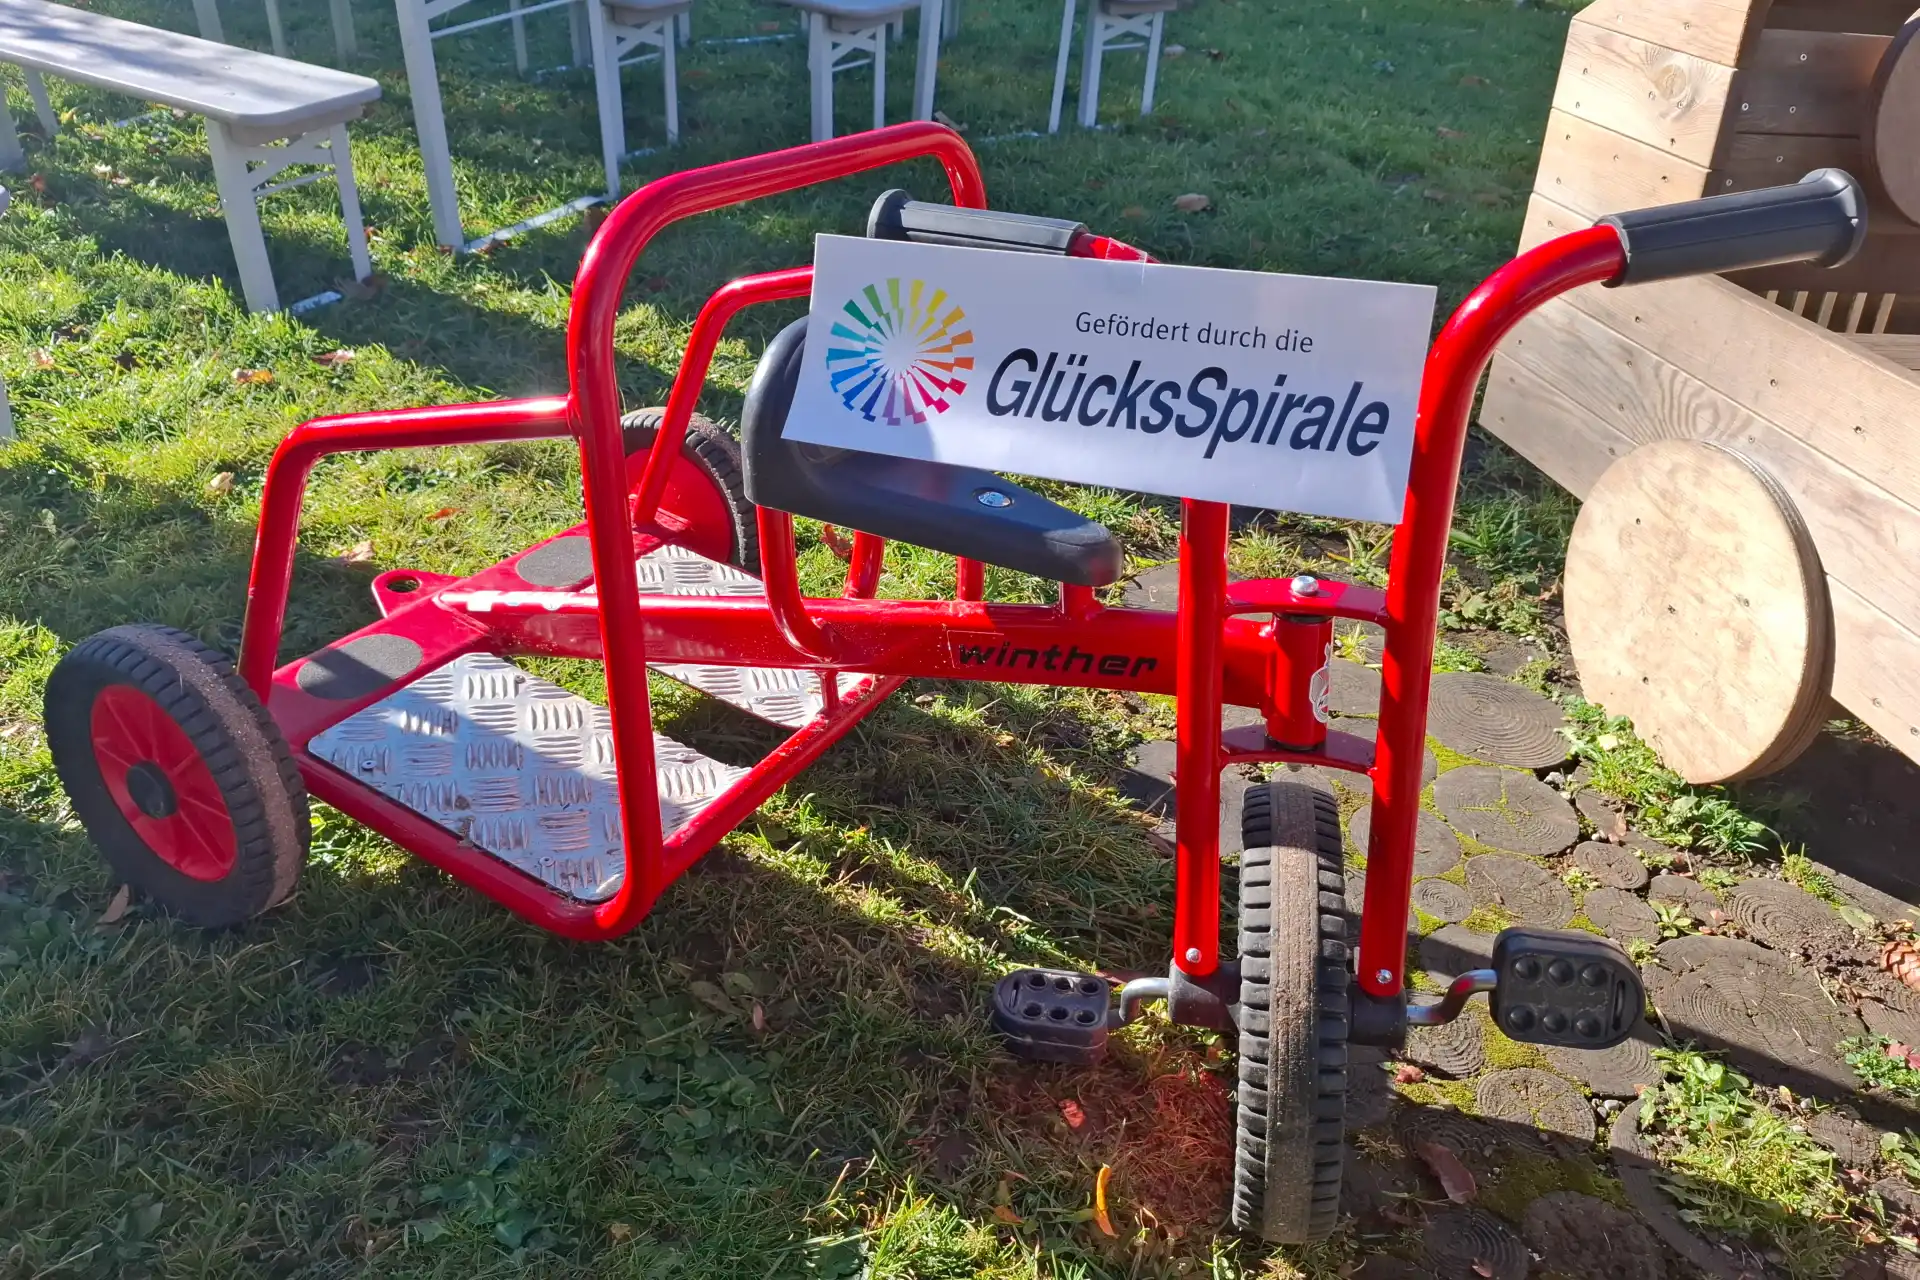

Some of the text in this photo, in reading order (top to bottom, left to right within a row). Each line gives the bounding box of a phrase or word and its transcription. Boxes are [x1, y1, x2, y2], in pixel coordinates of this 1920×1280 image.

[1075, 311, 1314, 353] Gefördert durch die
[986, 347, 1390, 460] GlücksSpirale
[958, 641, 1159, 678] winther
